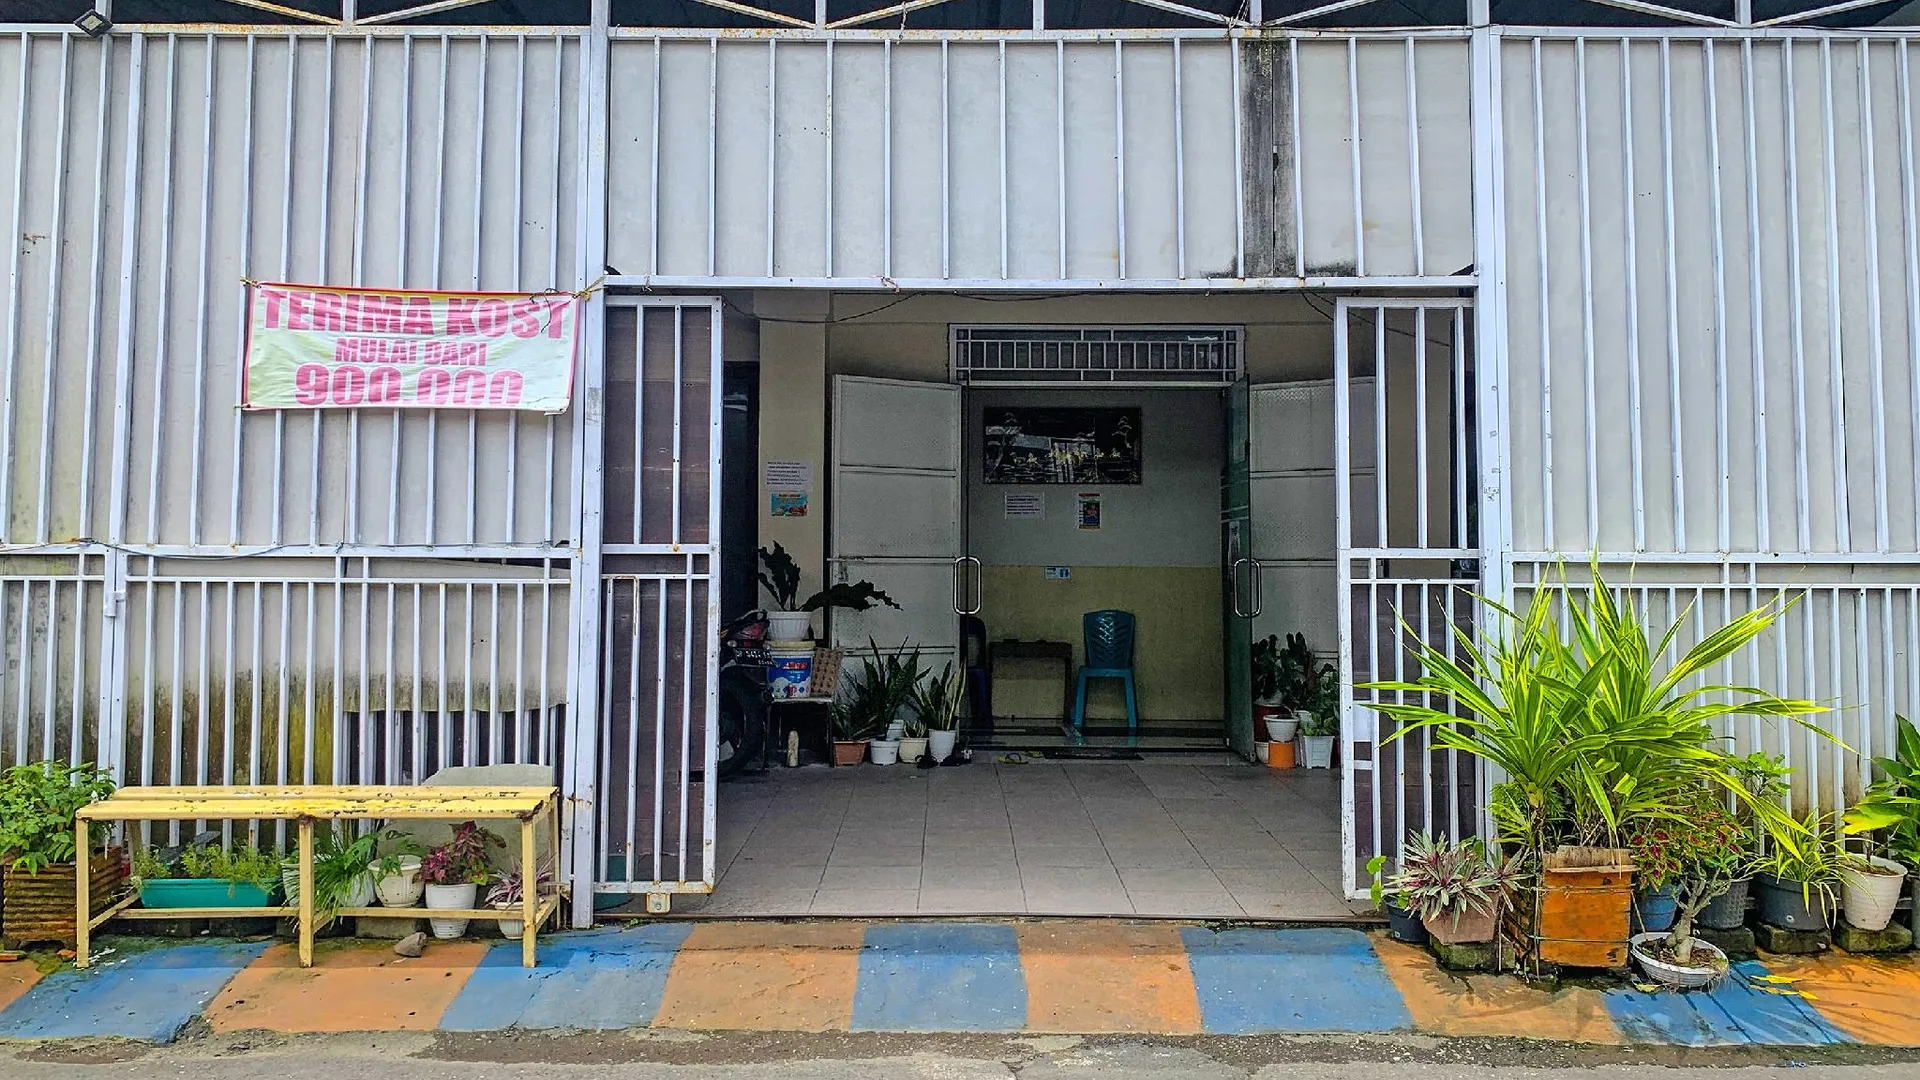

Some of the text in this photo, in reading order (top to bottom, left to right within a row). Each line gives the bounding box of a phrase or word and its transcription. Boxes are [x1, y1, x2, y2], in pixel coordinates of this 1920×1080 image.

[259, 289, 571, 340] TERIMA KOST
[334, 337, 487, 366] MULAI DARI
